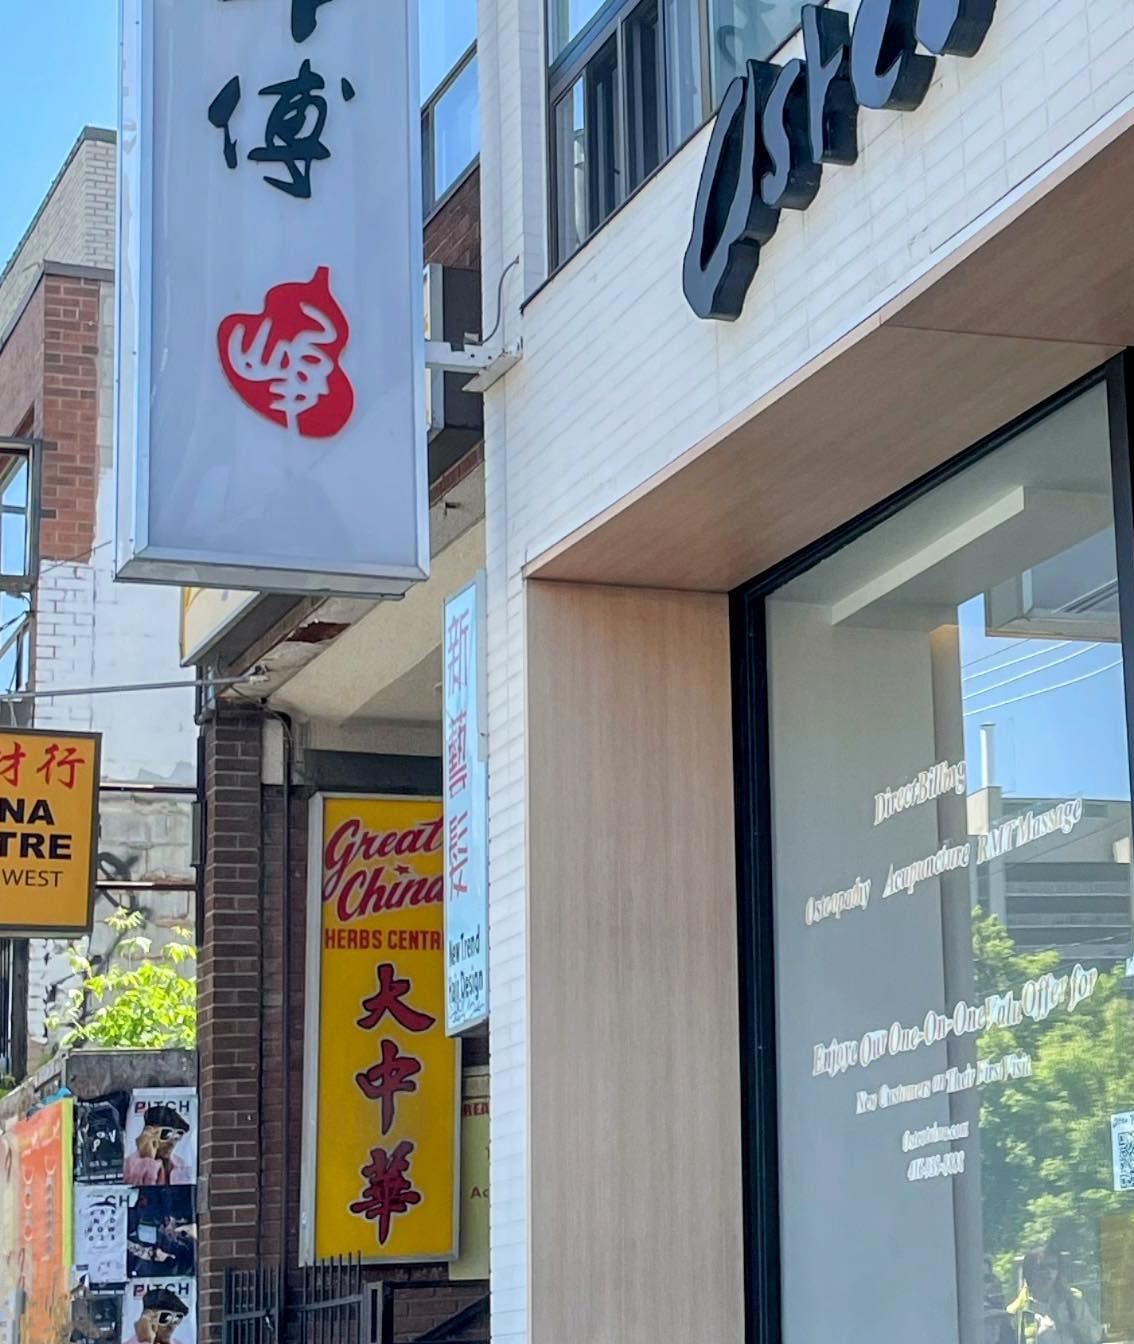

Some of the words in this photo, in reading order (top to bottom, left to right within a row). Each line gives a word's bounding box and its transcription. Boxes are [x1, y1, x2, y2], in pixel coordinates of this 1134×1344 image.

[0, 797, 55, 825] NA
[0, 832, 72, 860] TRE
[322, 818, 444, 902] Great
[2, 868, 63, 888] WEST
[337, 864, 444, 922] China
[325, 928, 383, 949] HERBS
[387, 929, 444, 950] CENTR
[349, 962, 436, 1246] 大中華
